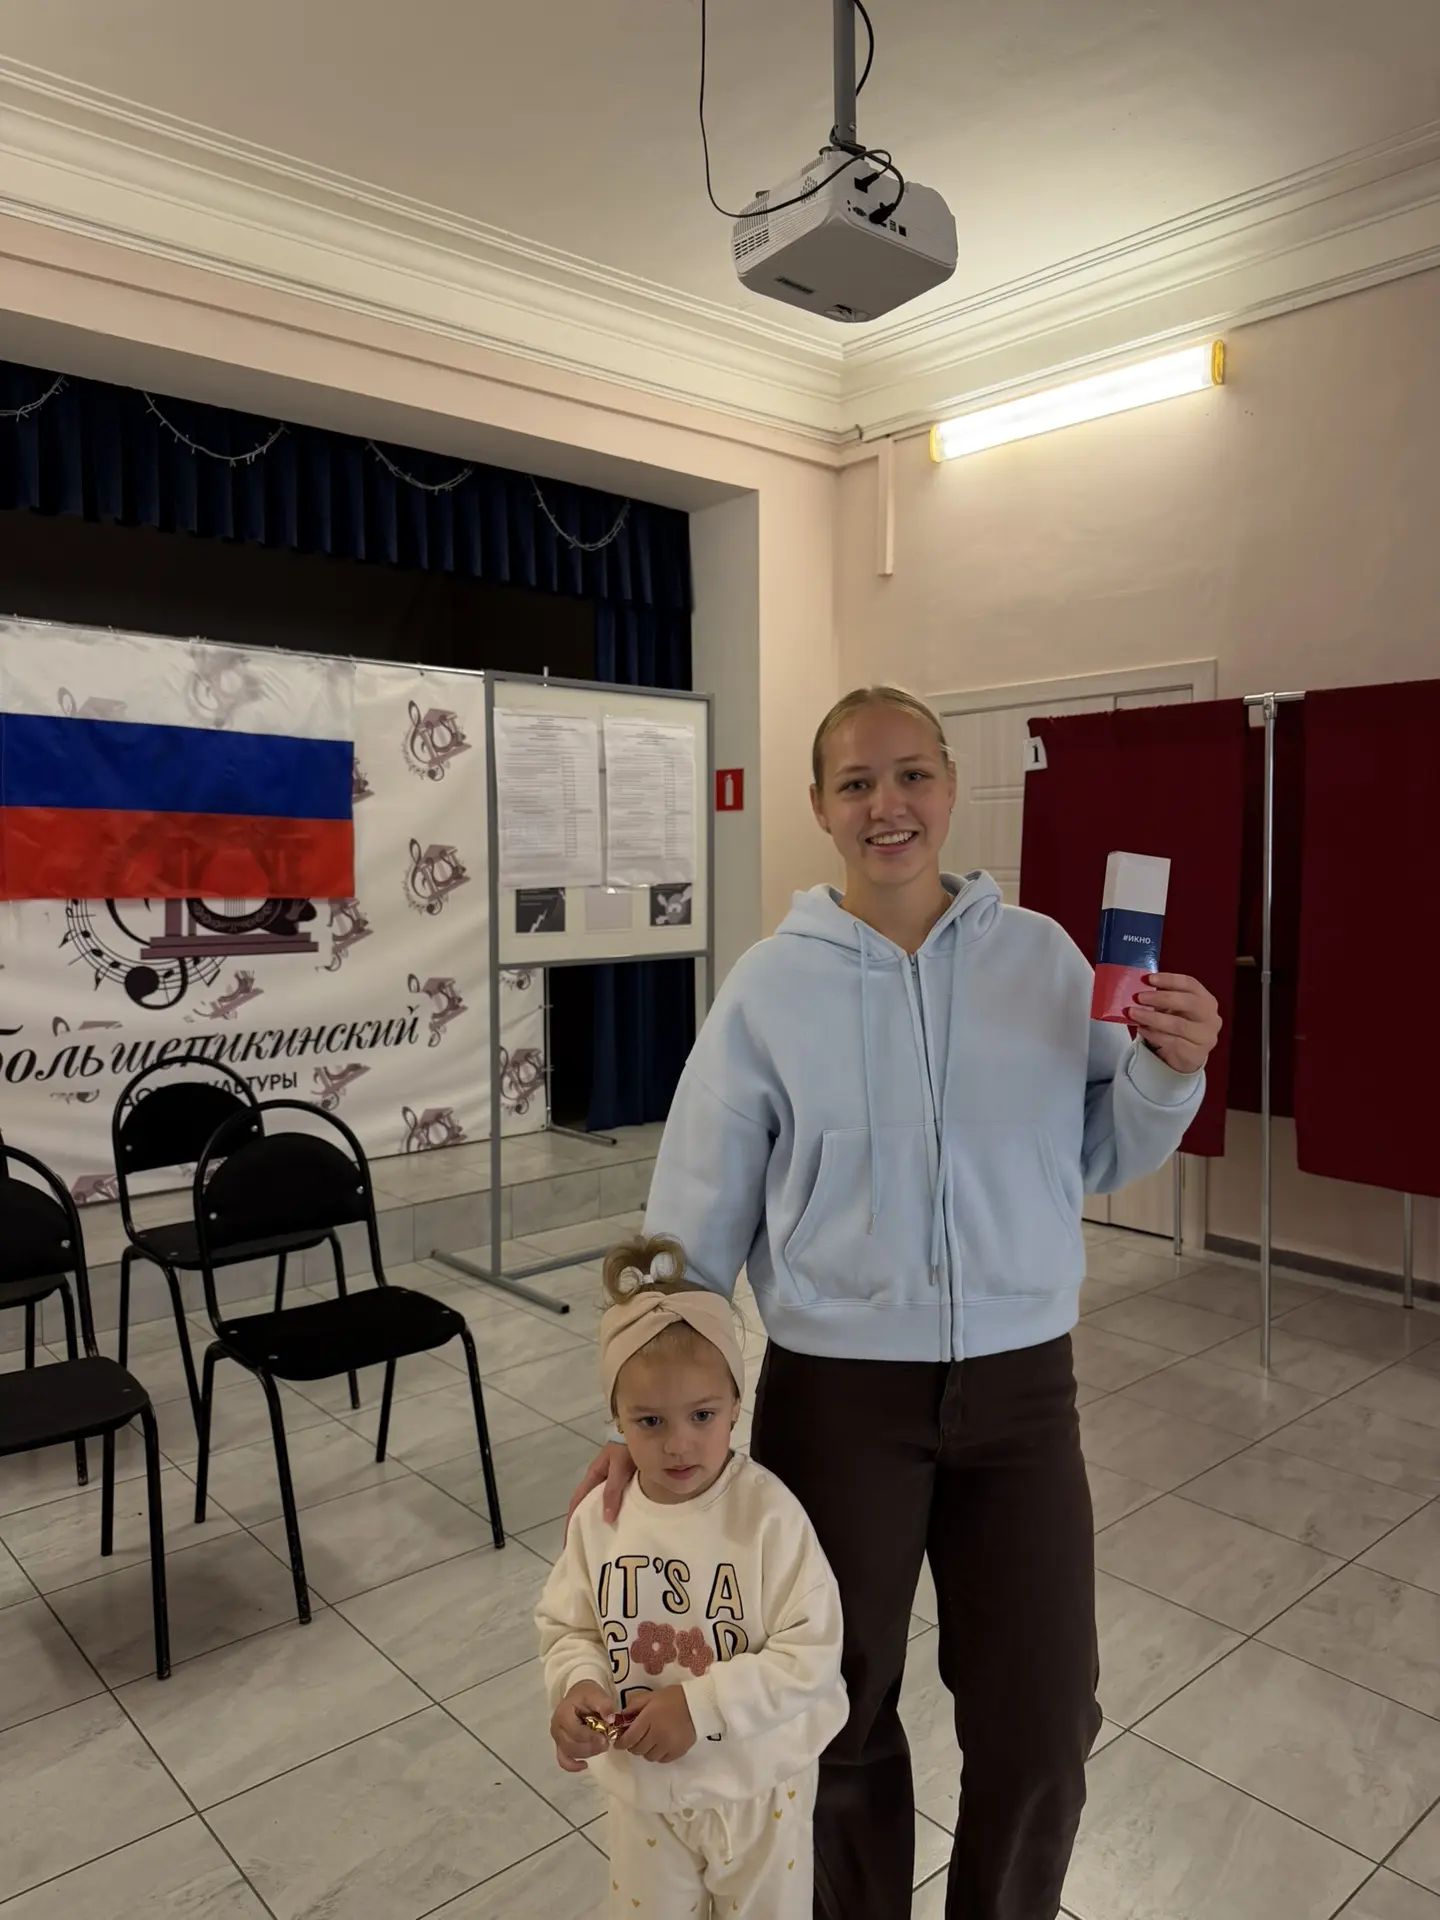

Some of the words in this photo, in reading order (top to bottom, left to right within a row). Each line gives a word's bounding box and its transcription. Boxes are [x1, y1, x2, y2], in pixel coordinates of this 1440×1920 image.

[1032, 744, 1040, 763] 1
[1122, 934, 1152, 945] #ИКНО
[598, 1555, 690, 1619] IT'S
[705, 1563, 744, 1621] A
